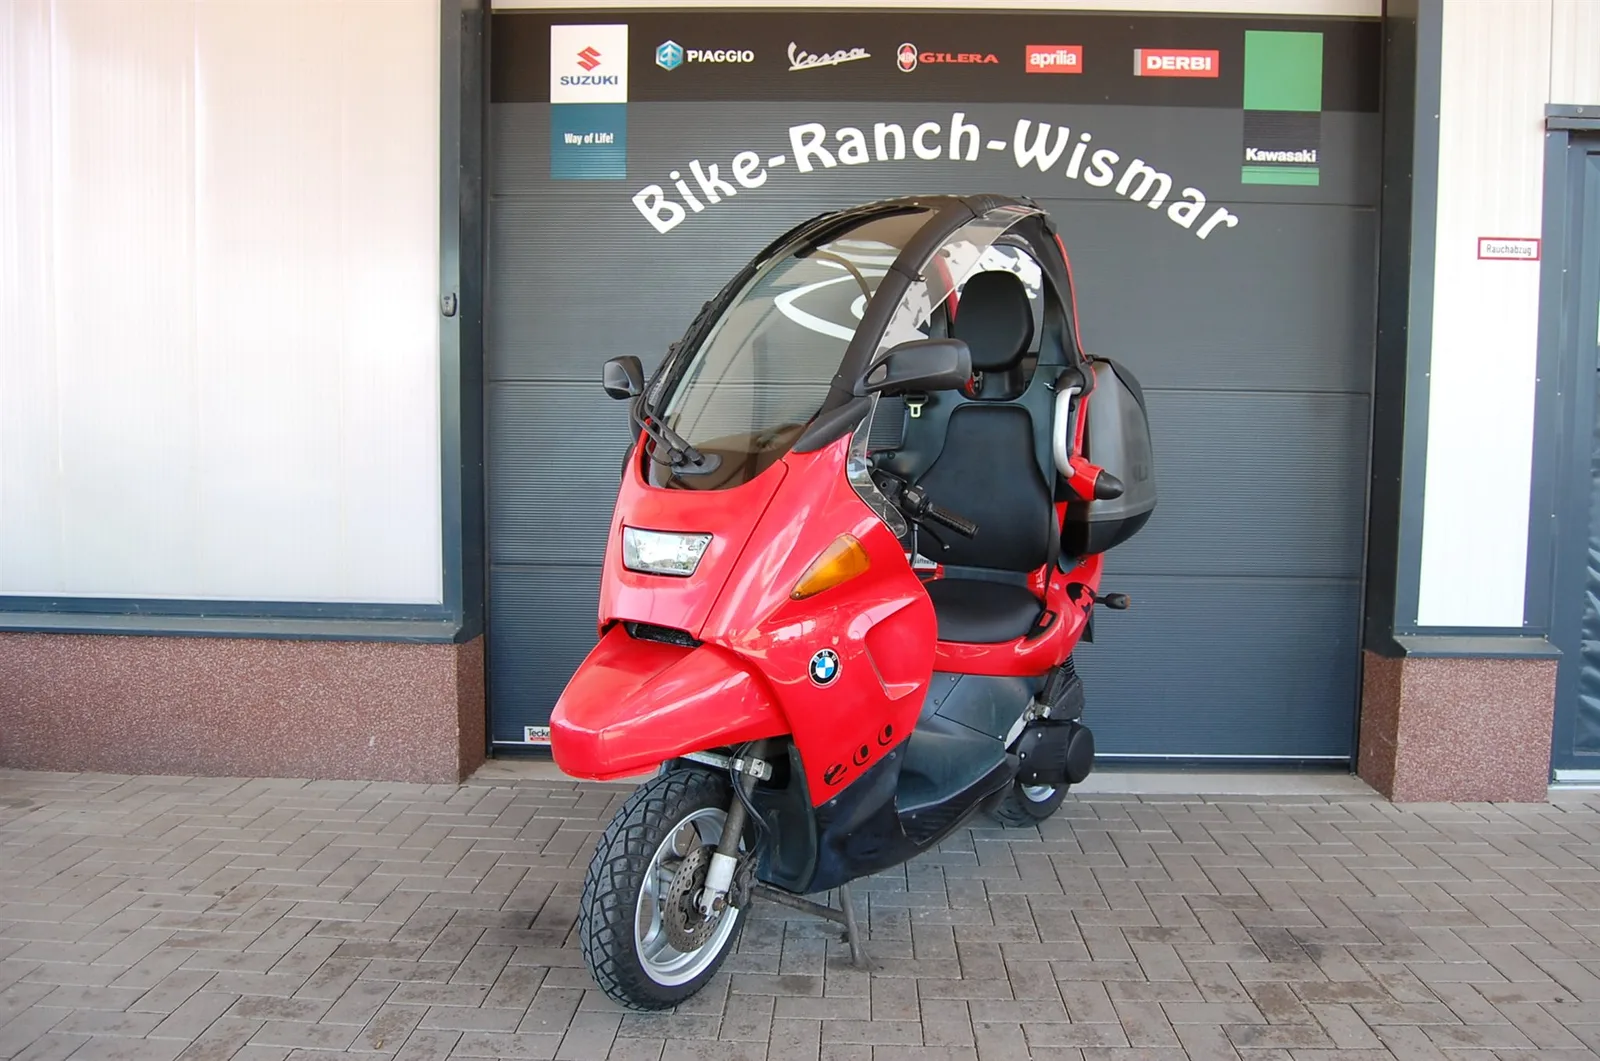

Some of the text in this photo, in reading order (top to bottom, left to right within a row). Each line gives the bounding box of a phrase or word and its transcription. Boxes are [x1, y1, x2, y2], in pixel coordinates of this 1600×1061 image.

[686, 49, 755, 63] PIAGGIO
[787, 41, 871, 71] Vespa
[918, 51, 1000, 65] GILERA
[1030, 50, 1077, 67] aprilia
[1146, 55, 1212, 71] DERBI
[560, 75, 618, 86] SUZUKI
[564, 132, 614, 146] Way of Life!
[1245, 147, 1317, 163] Kawasaki
[1486, 243, 1532, 257] Rauchabzug
